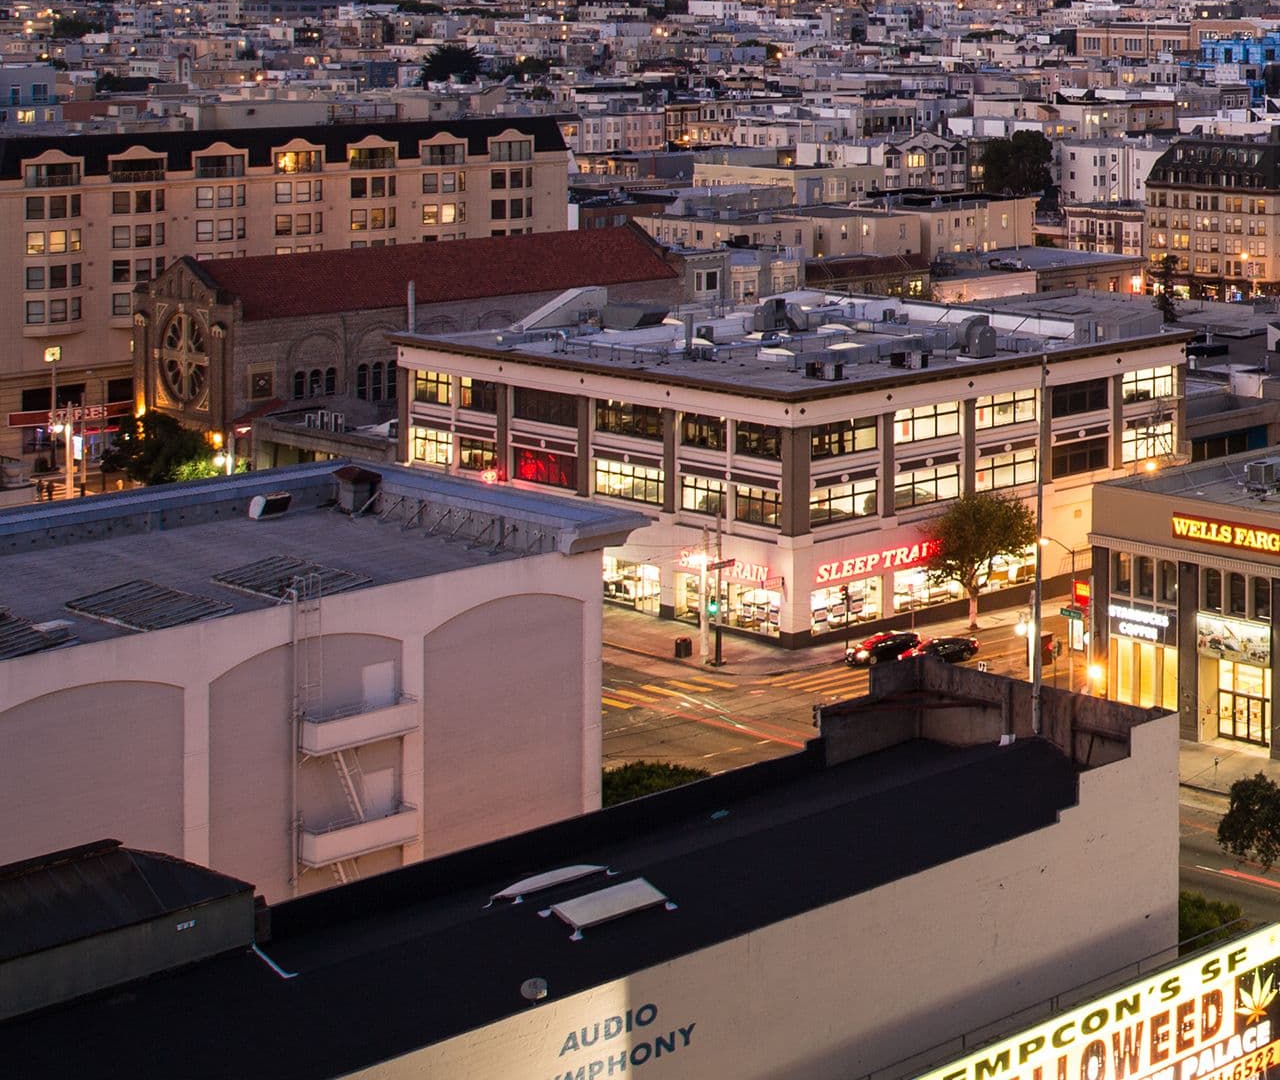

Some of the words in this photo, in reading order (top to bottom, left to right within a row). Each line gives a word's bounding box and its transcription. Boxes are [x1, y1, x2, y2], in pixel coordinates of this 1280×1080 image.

[1172, 517, 1233, 544] WELLS
[815, 553, 881, 583] SLEEP
[881, 540, 943, 569] TRAI
[1201, 947, 1248, 984] SF
[558, 1003, 658, 1057] AUDIO
